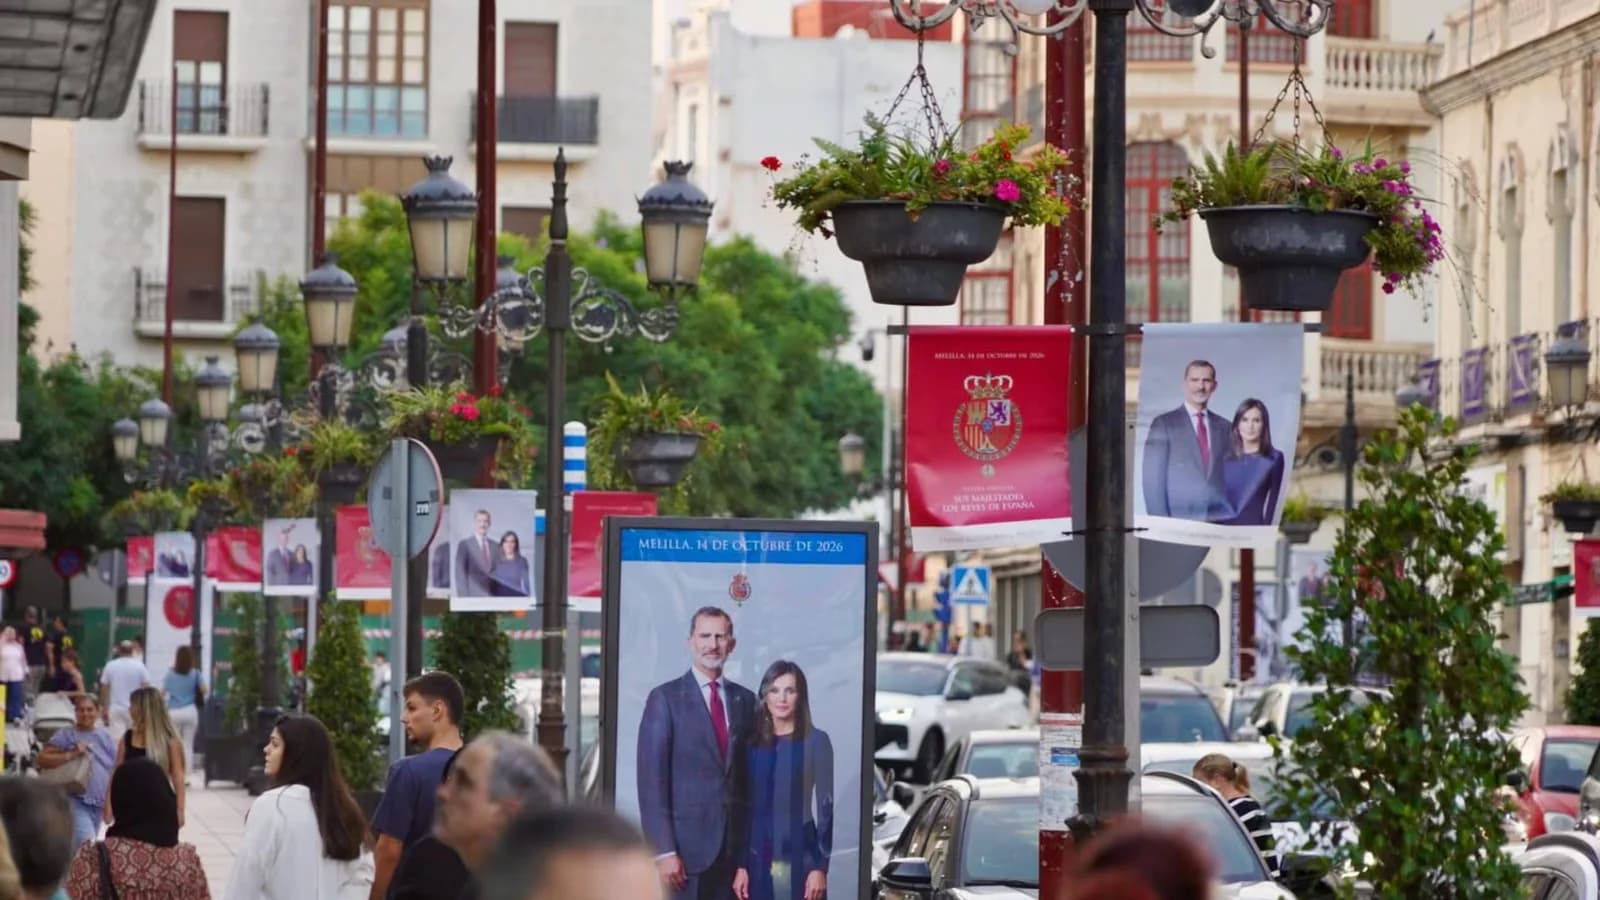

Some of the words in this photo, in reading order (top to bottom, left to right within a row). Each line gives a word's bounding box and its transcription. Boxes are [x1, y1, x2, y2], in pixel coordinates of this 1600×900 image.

[972, 493, 1024, 503] MAJESTADES
[942, 503, 958, 512] LOS
[960, 502, 985, 512] REYES
[988, 502, 1000, 511] DE
[1002, 500, 1035, 511] ESPAÑA
[697, 539, 708, 550] 14
[712, 539, 729, 551] DE
[732, 539, 792, 551] OCTUBRE
[796, 540, 812, 552] DE
[816, 540, 844, 552] 2026
